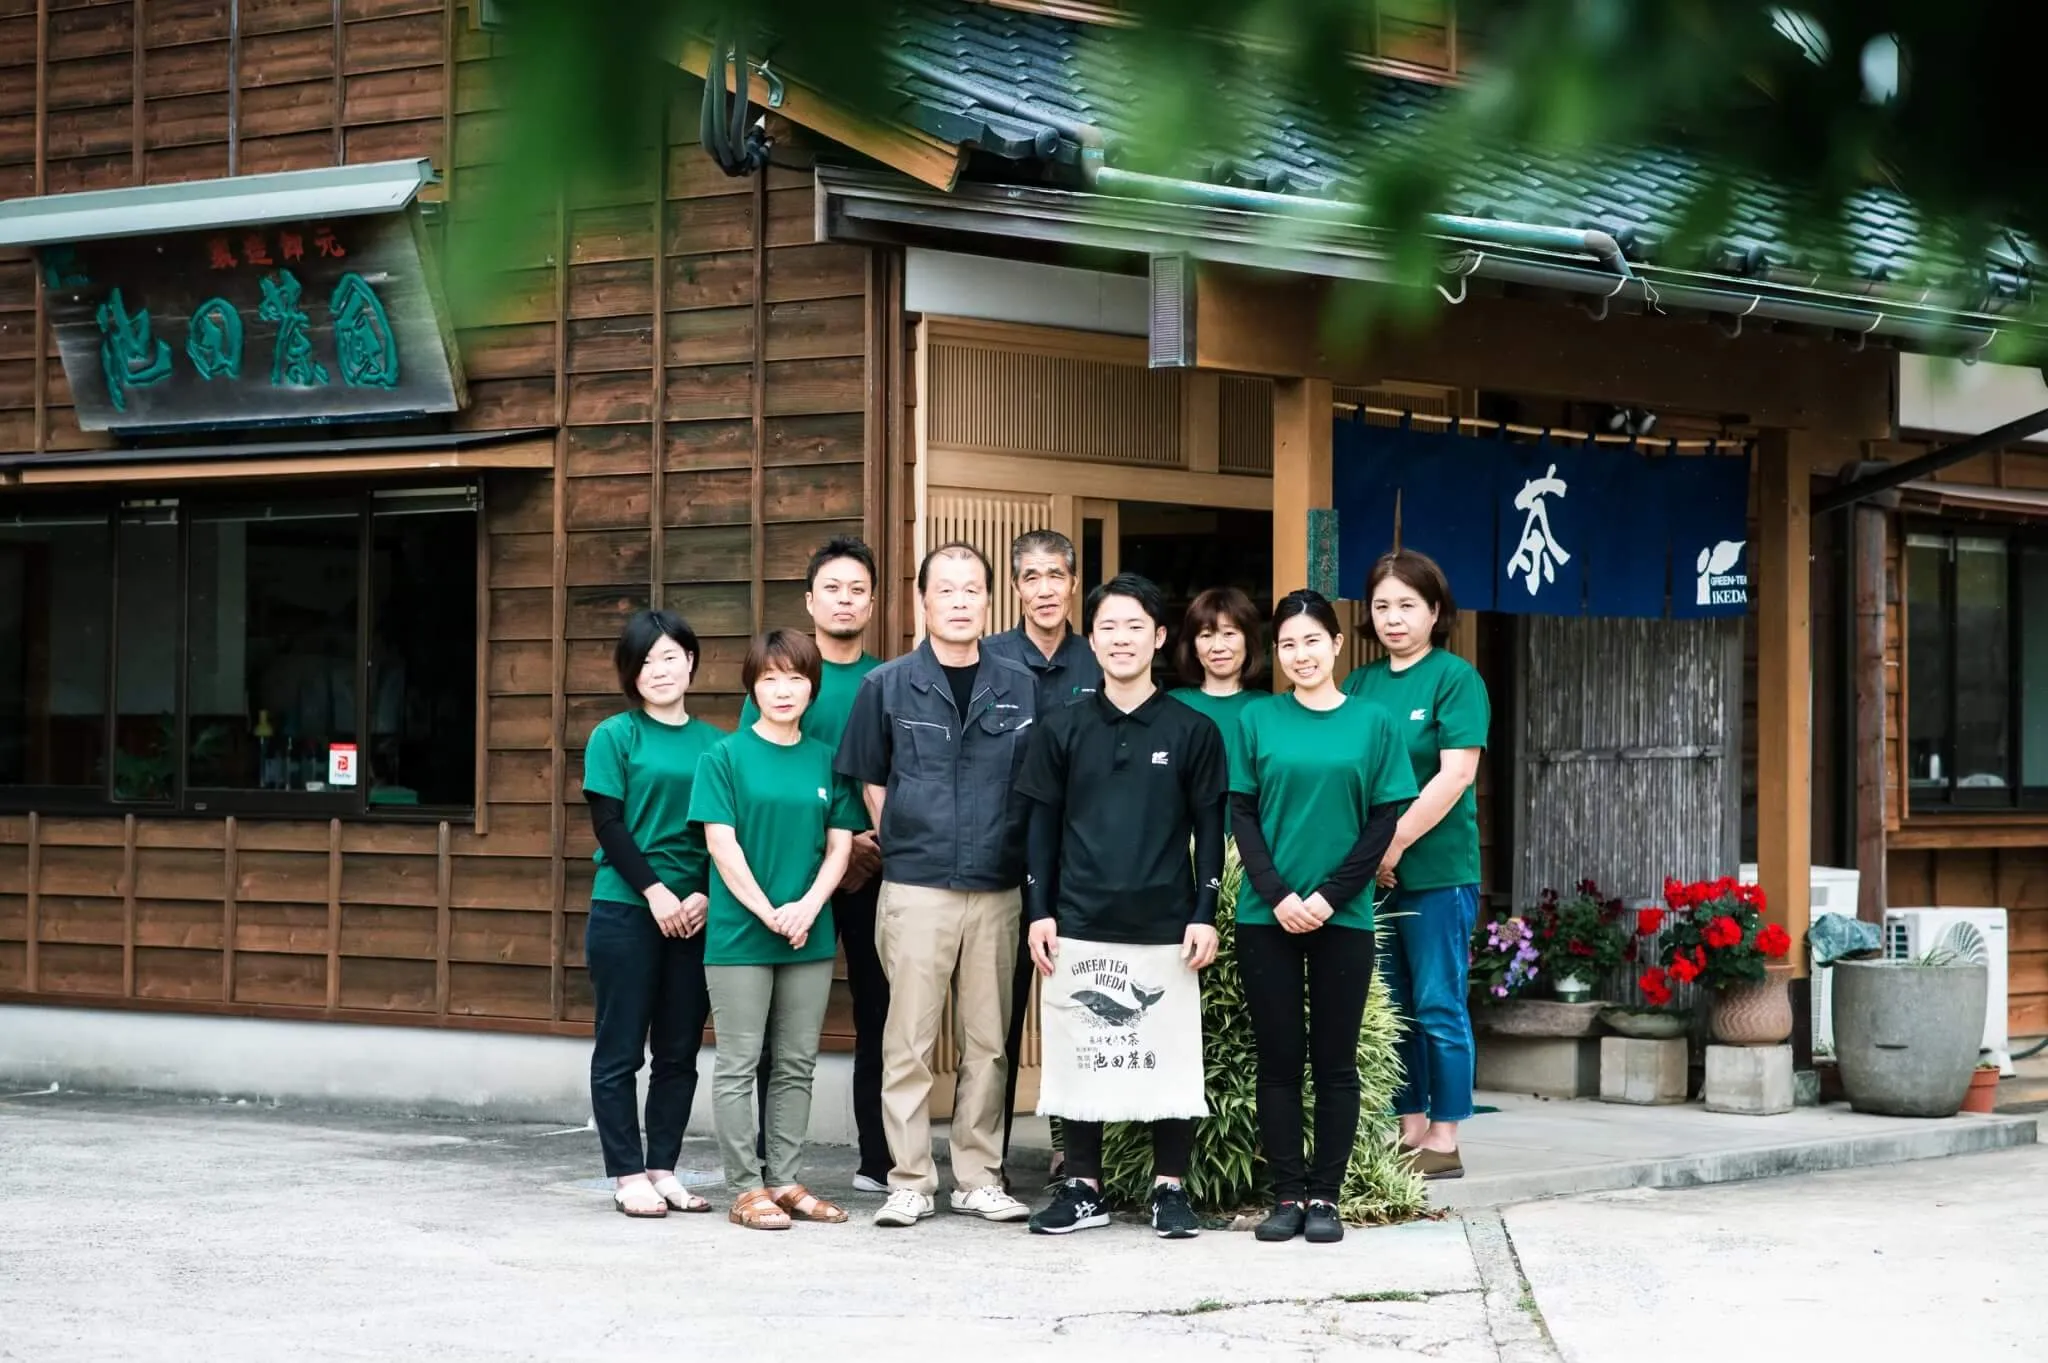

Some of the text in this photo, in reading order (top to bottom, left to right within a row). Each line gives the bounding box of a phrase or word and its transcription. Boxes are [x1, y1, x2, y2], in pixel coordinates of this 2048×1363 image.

[96, 267, 399, 414] 池田茶園
[1507, 463, 1571, 596] 茶
[1712, 589, 1748, 604] IKEDA
[1071, 958, 1128, 976] GREEN TEA
[1095, 973, 1126, 992] IKEDA
[1093, 1050, 1156, 1072] 池田茶園
